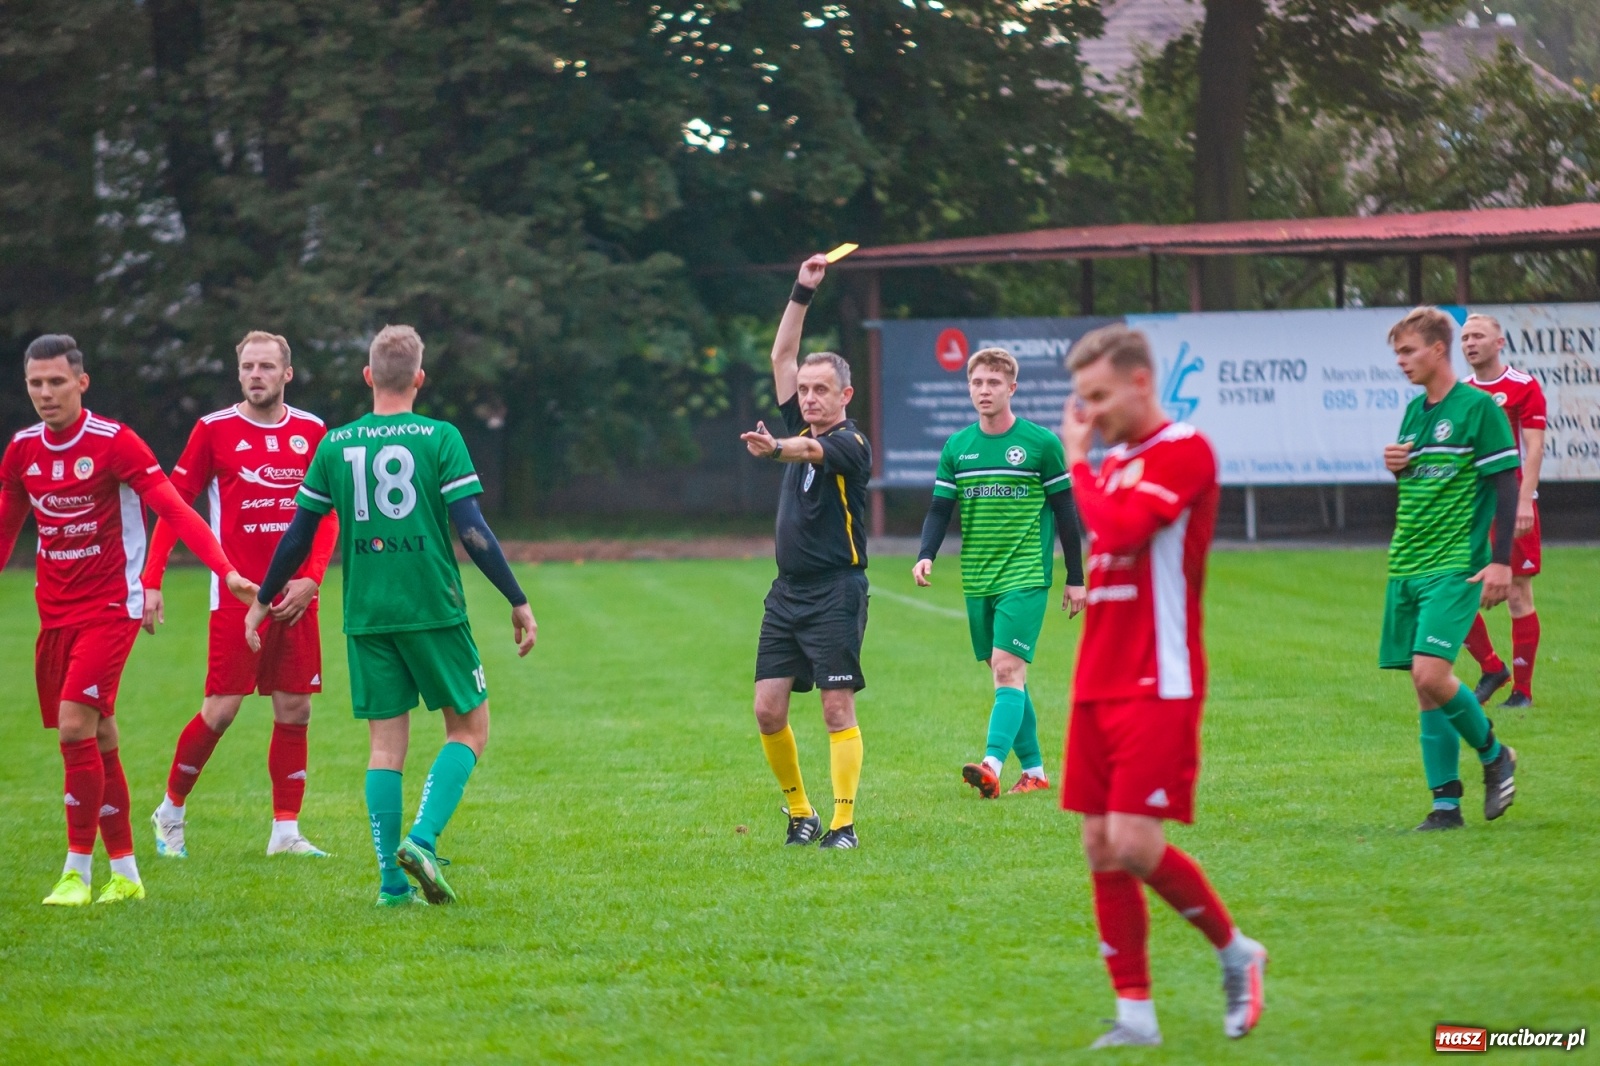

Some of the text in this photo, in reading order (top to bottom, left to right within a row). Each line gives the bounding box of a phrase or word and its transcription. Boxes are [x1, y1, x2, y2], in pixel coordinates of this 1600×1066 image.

[1501, 327, 1600, 355] AMIEN
[1219, 358, 1307, 383] ELEKTRO
[1219, 388, 1275, 405] SYSTEM
[1323, 389, 1358, 410] 695
[1366, 389, 1399, 410] 729
[343, 444, 417, 522] 18
[259, 522, 292, 533] WENIN
[48, 545, 101, 560] WENINGER
[354, 535, 427, 555] ROSAT
